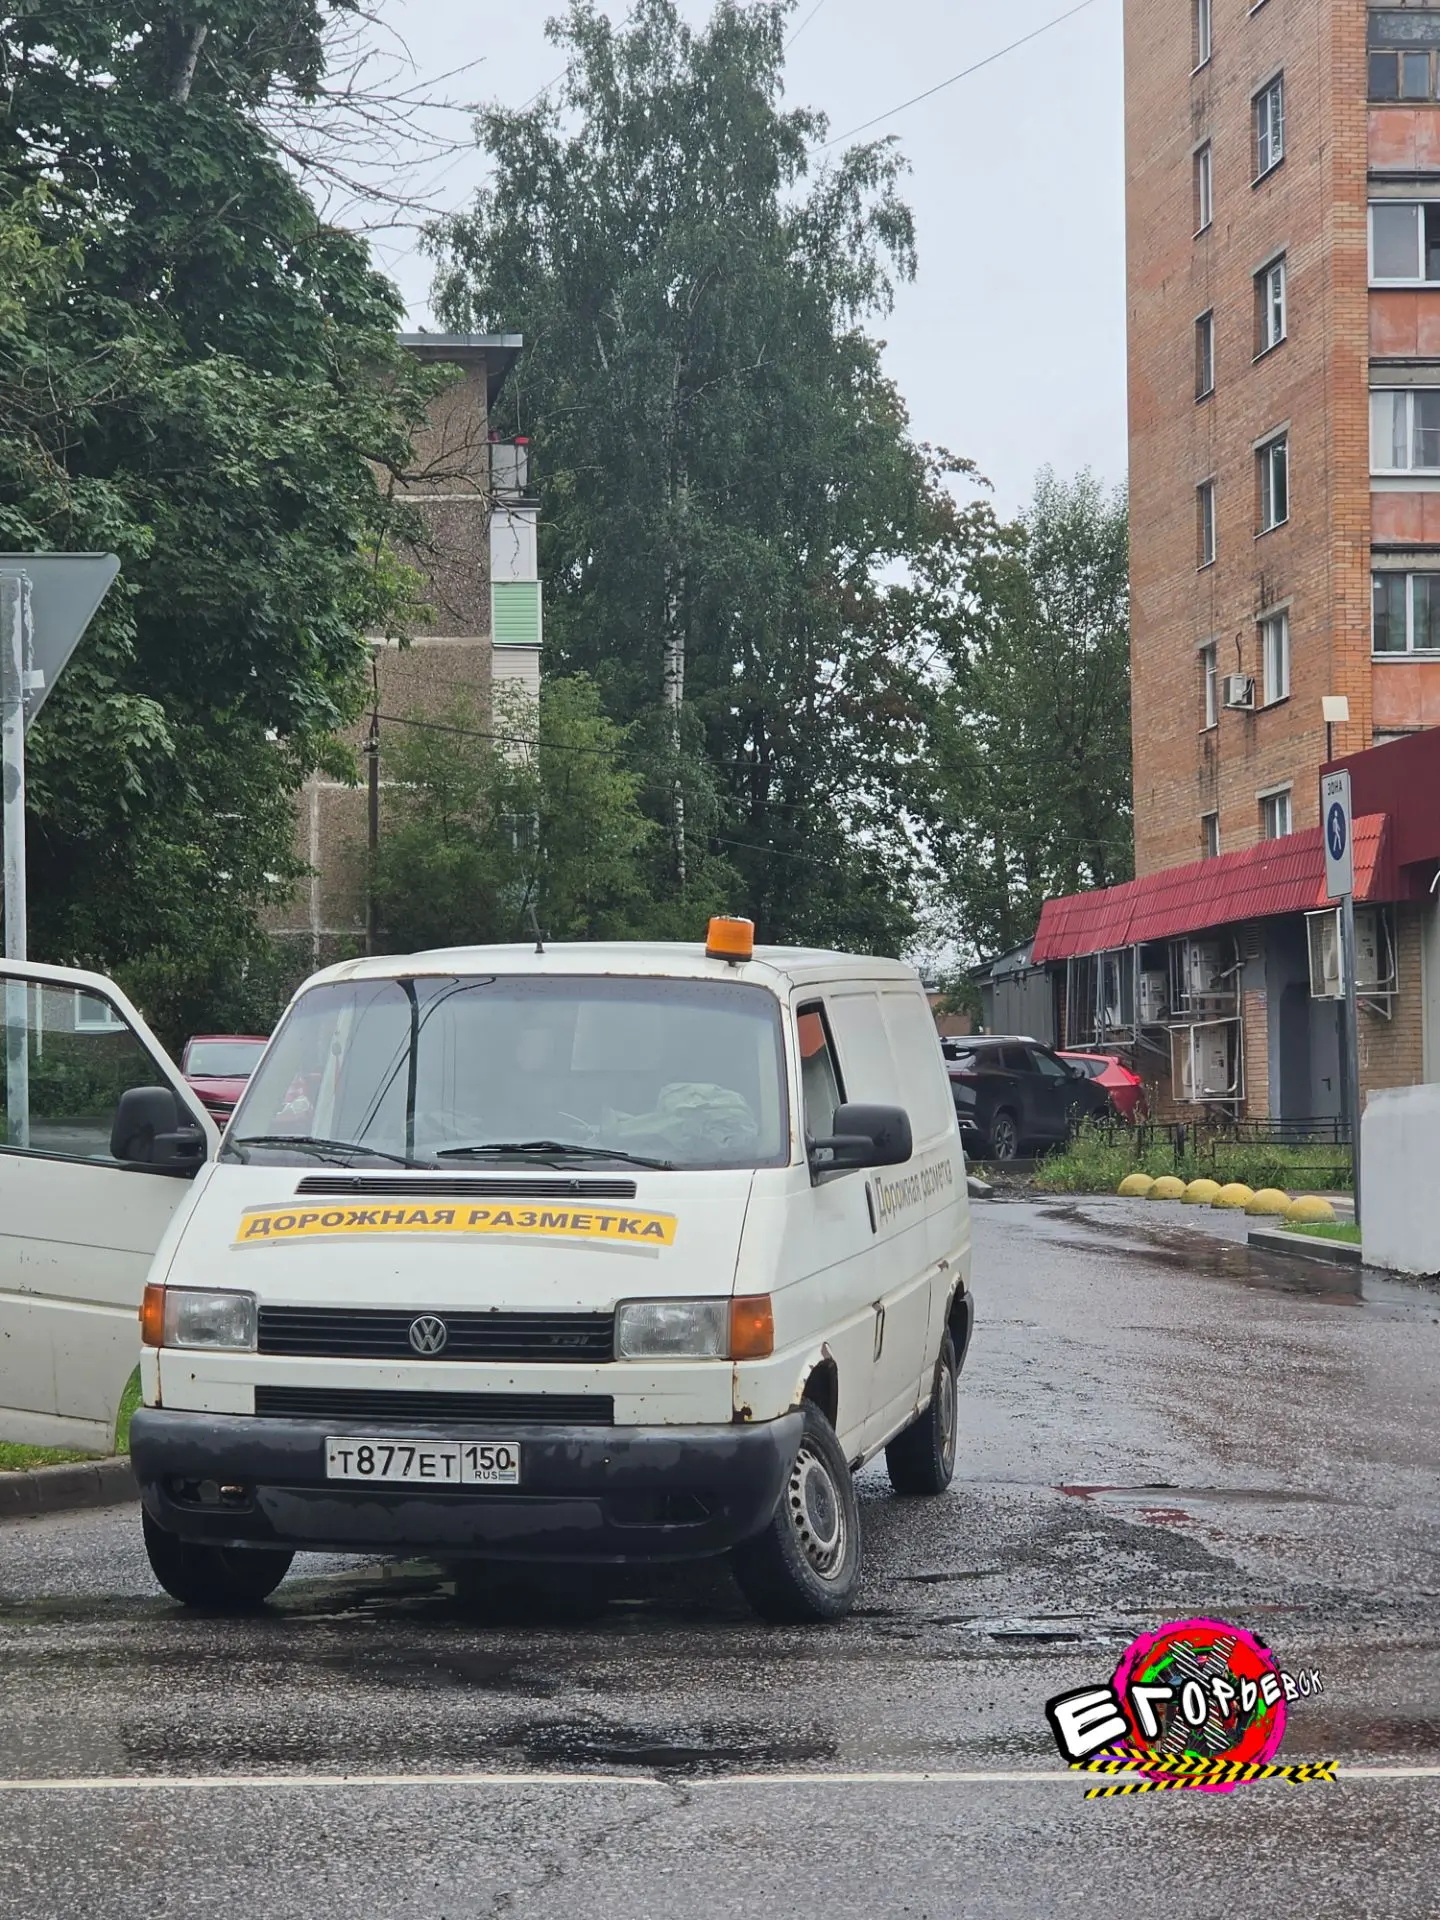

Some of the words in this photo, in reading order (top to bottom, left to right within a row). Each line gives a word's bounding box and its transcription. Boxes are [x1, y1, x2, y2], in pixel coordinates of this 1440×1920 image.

[1327, 780, 1343, 796] ЗОНА
[875, 1176, 921, 1224] Дорожная
[245, 1209, 456, 1238] ДОРОЖНАЯ
[467, 1210, 666, 1240] РАЗМЕТКА
[337, 1445, 457, 1478] Т877ЕТ
[465, 1446, 511, 1471] 150
[474, 1470, 498, 1480] RUS
